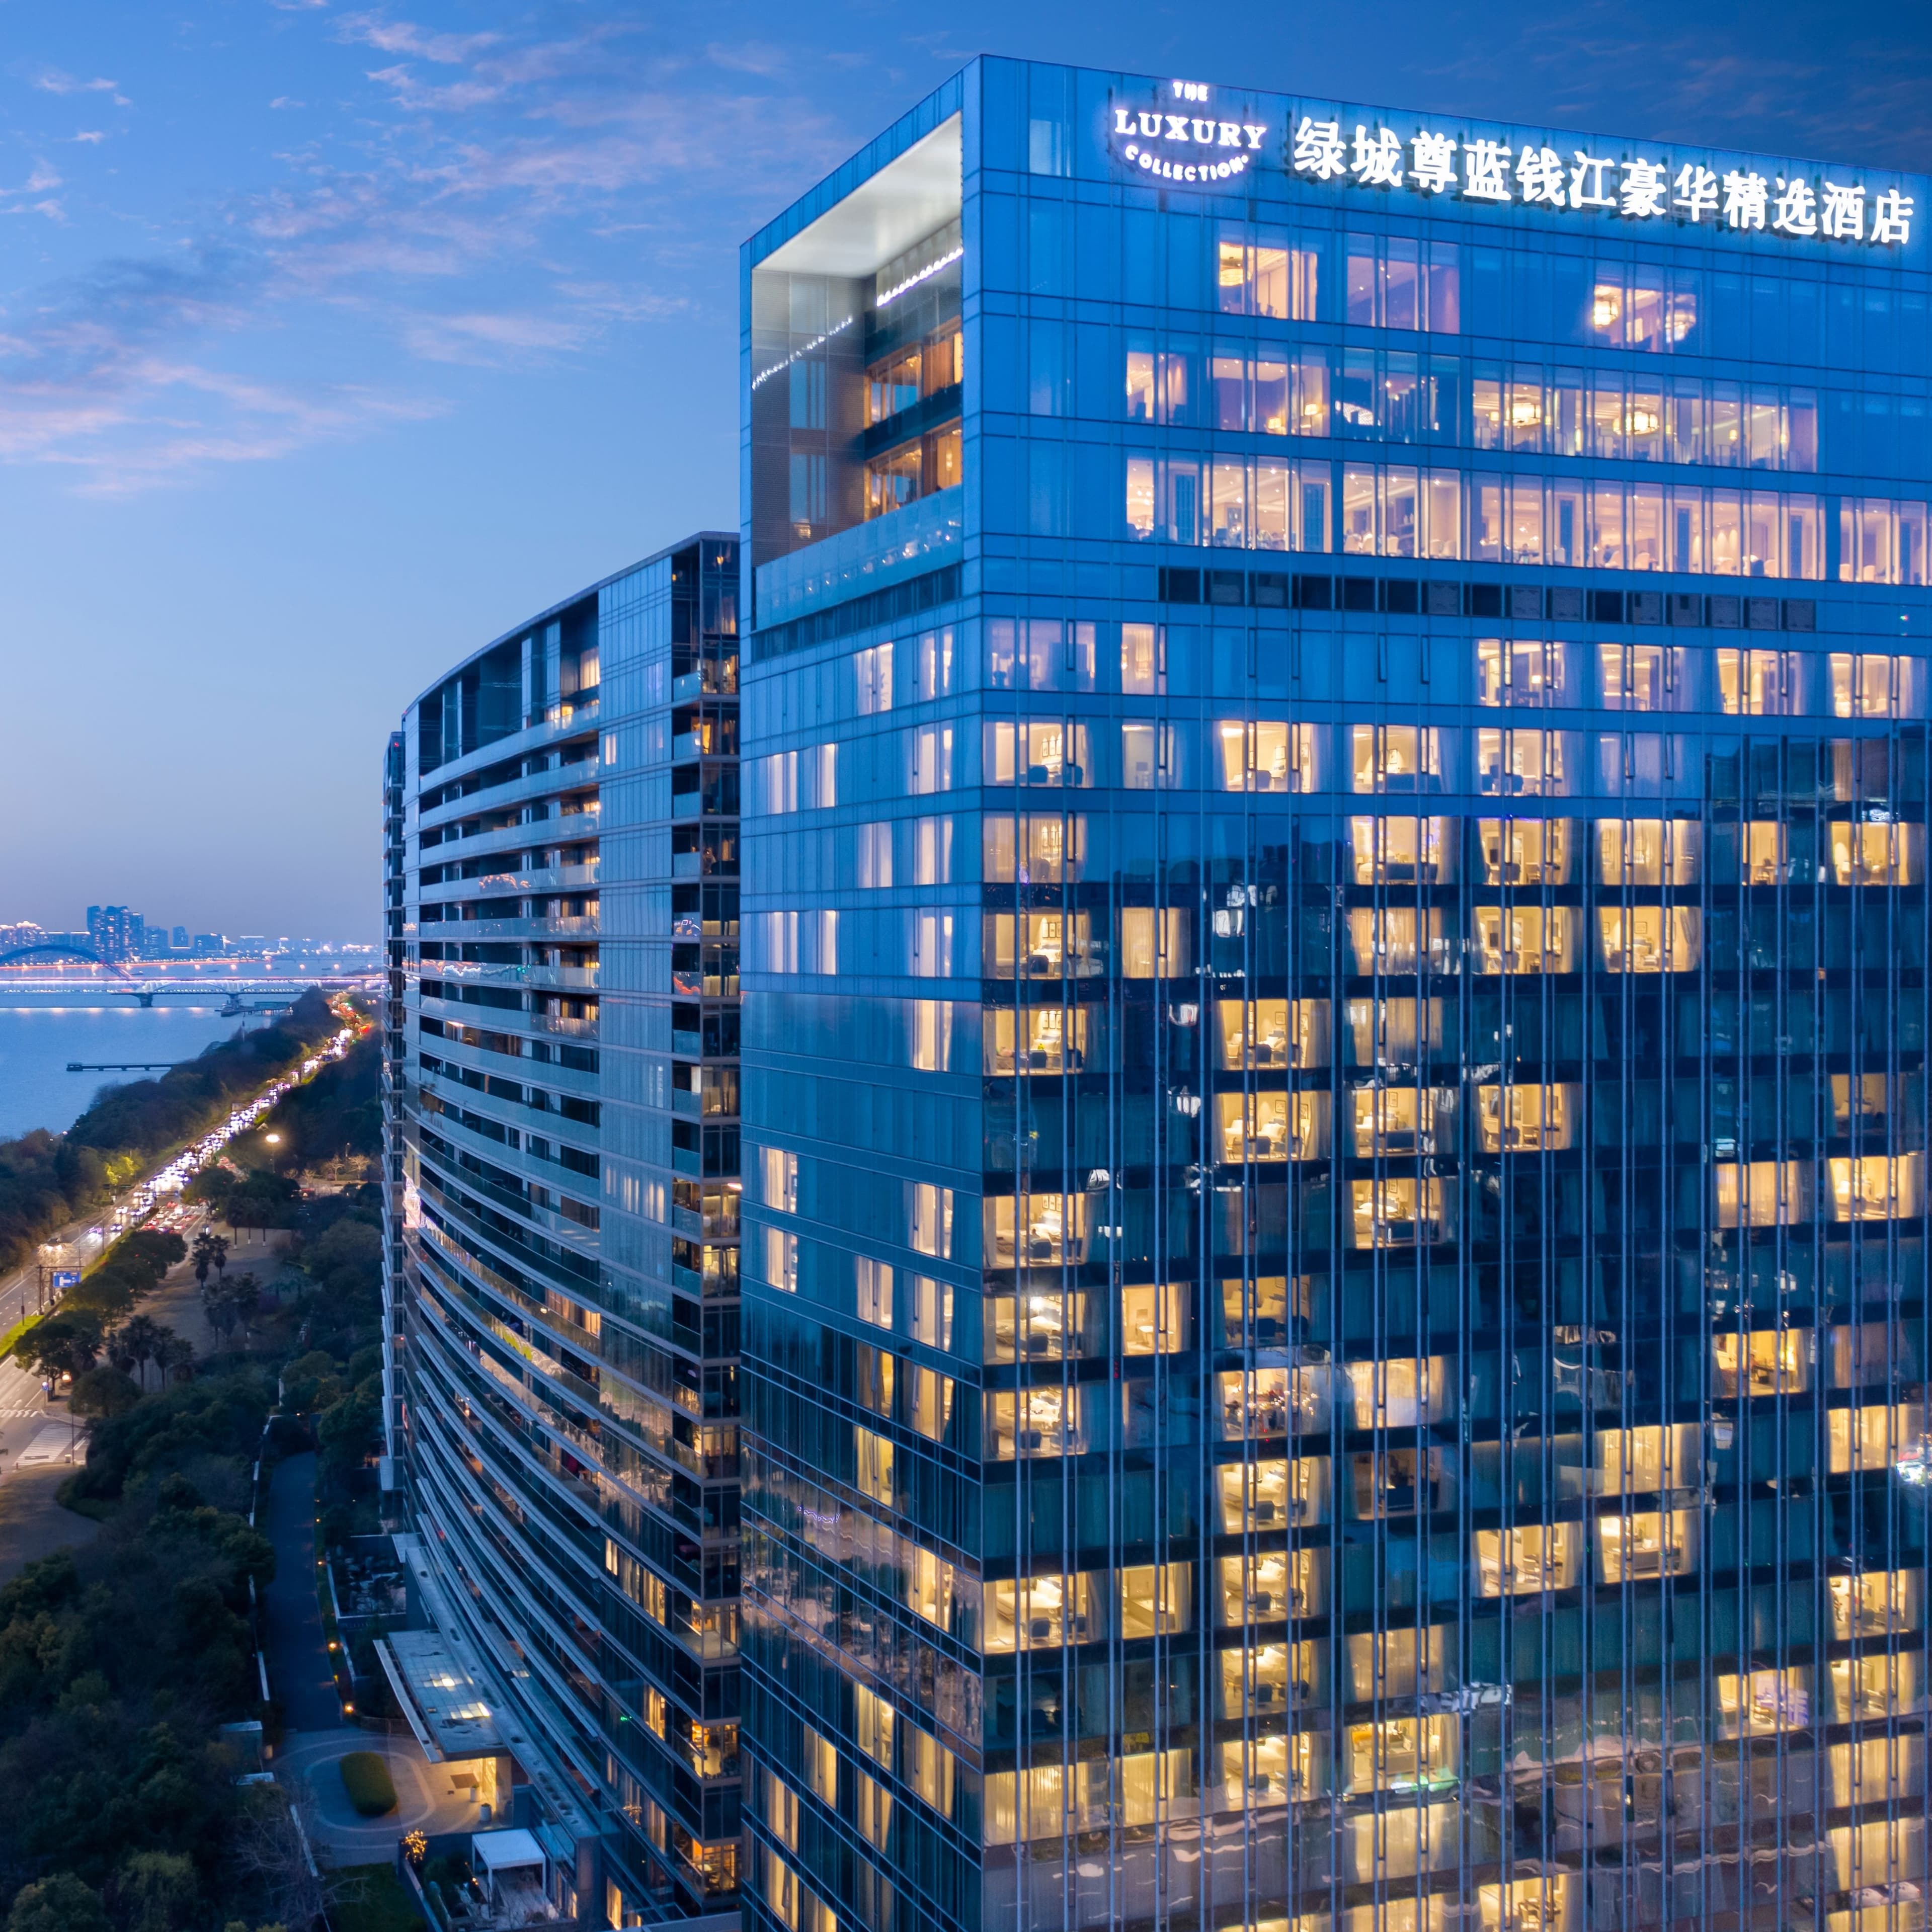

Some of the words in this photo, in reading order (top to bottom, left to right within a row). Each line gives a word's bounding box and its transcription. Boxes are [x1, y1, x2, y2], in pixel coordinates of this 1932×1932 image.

[1172, 82, 1208, 101] THE
[1114, 109, 1266, 148] LUXURY
[1125, 145, 1244, 181] COLLECTION
[1294, 116, 1914, 245] 绿城尊蓝钱江豪华精选酒店
